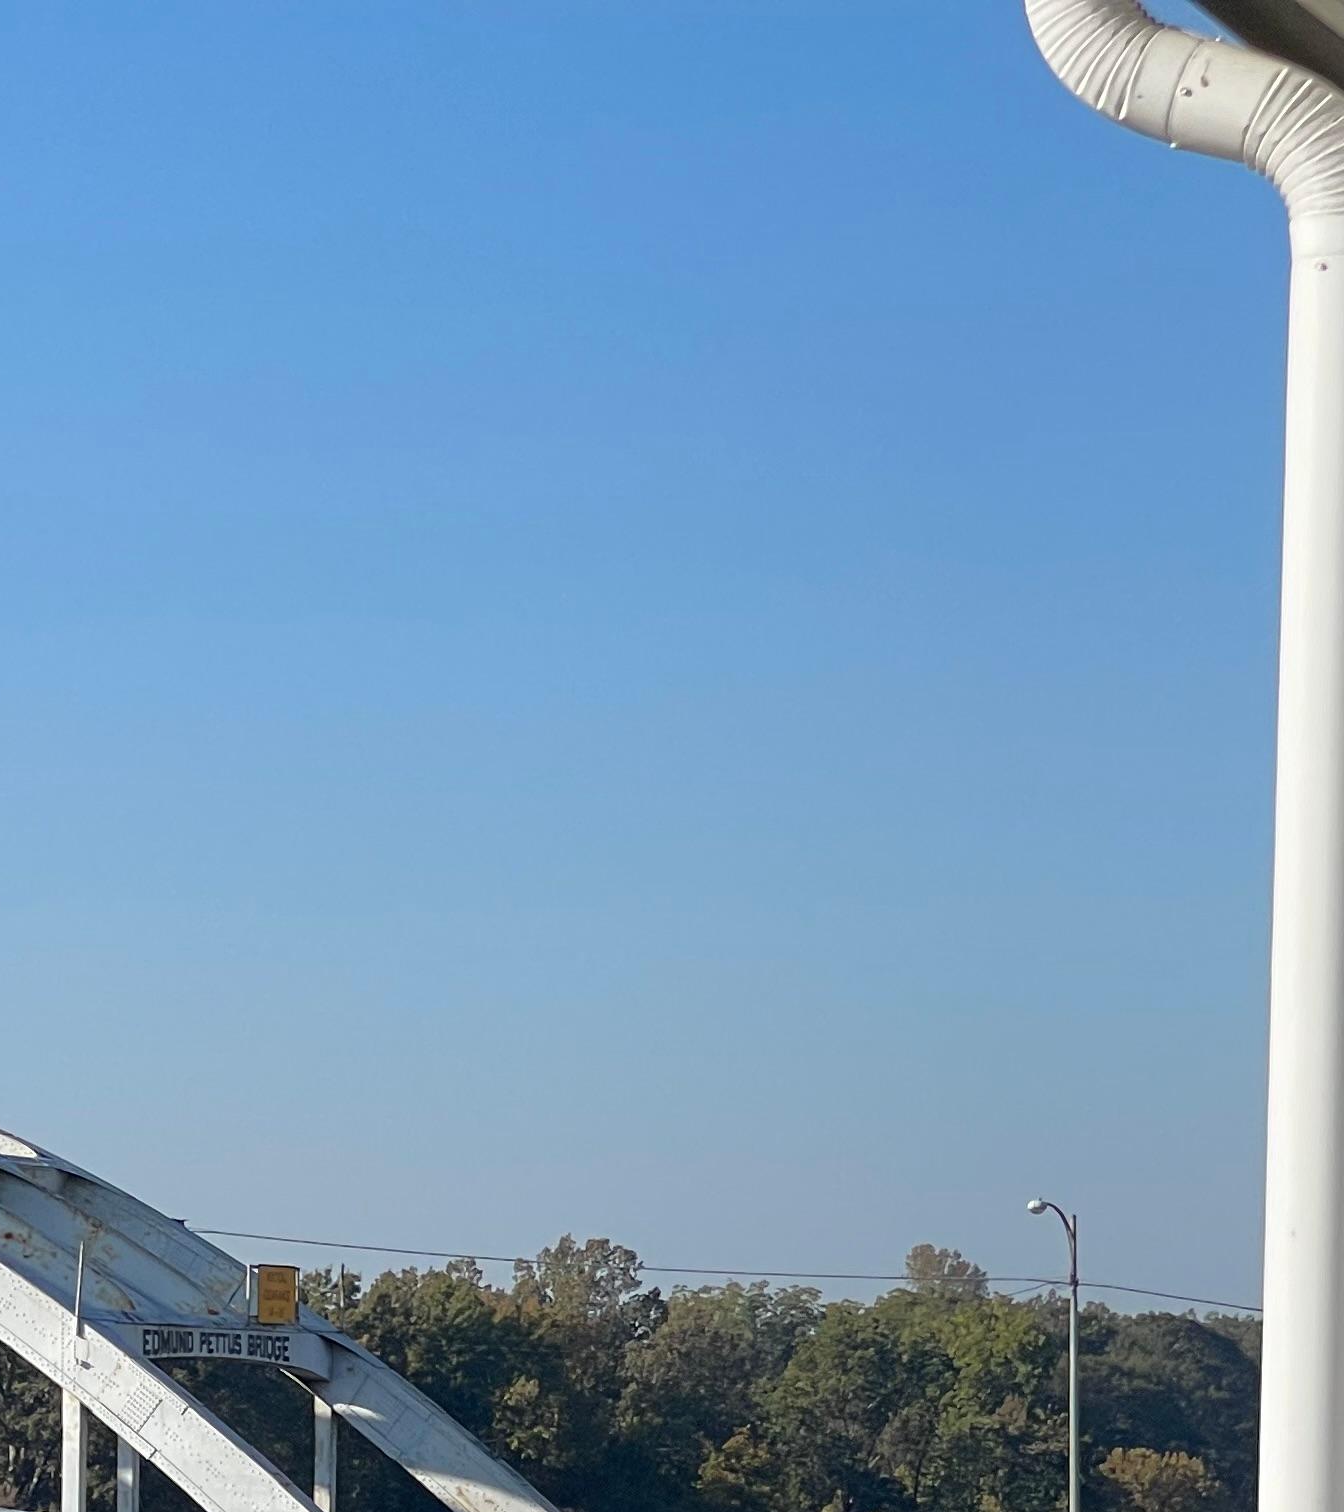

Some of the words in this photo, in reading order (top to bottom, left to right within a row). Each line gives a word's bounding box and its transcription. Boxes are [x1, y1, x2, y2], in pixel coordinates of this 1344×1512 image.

[142, 1328, 194, 1356] EDMUND
[199, 1331, 242, 1355] PETTUS
[247, 1334, 290, 1362] BRIDGE
